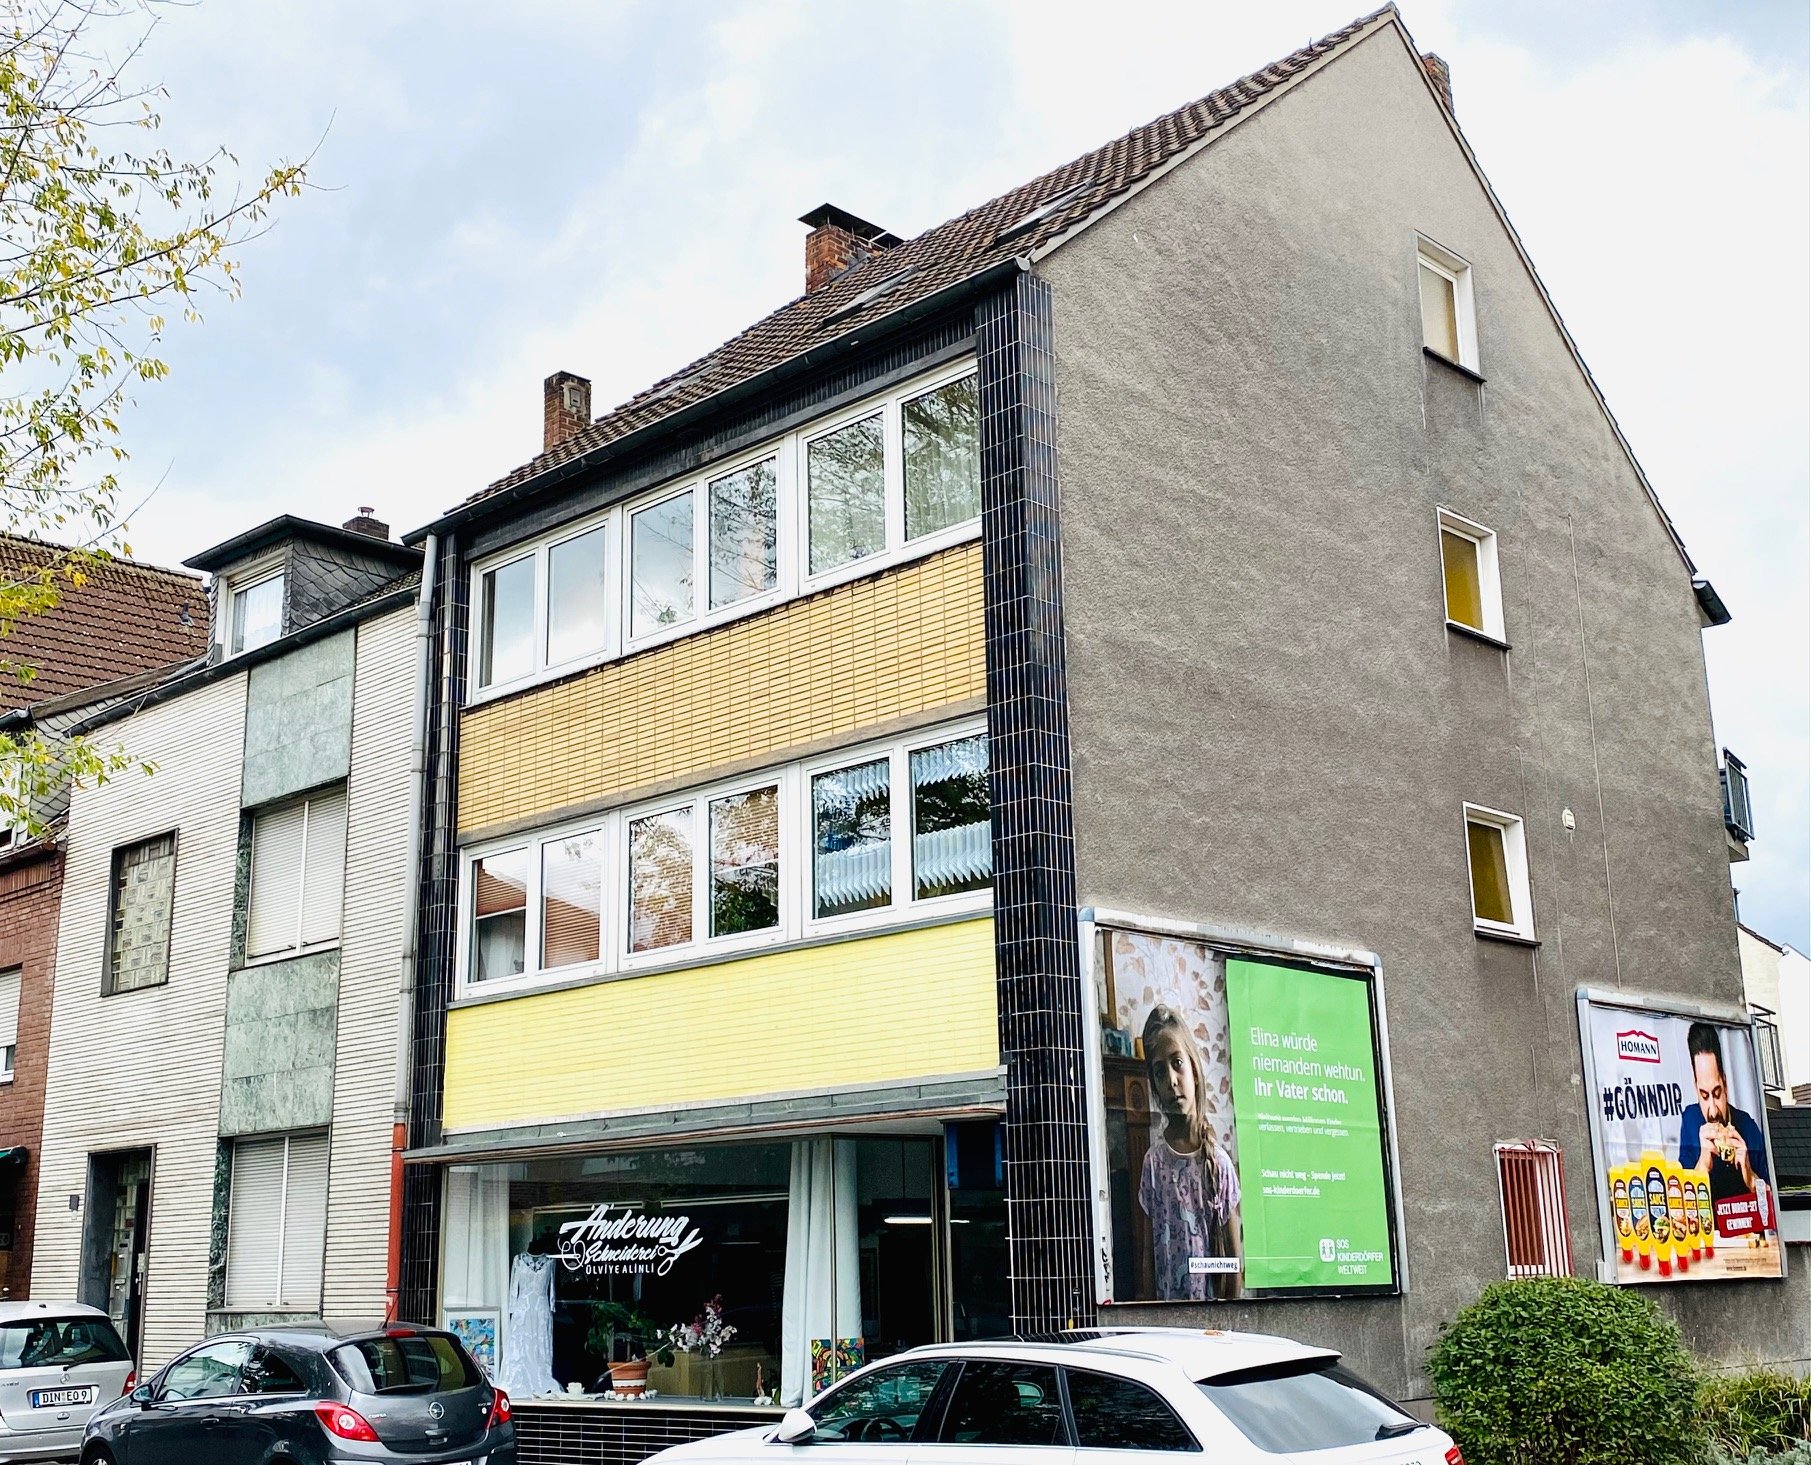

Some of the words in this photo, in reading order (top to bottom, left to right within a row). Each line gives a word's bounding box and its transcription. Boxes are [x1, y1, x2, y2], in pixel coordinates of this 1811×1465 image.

[1250, 1027, 1279, 1048] Elina
[1281, 1033, 1318, 1052] würde
[1620, 1039, 1658, 1056] HOMANN
[1252, 1053, 1322, 1077] niemandem
[1323, 1063, 1366, 1082] wehtun.
[1254, 1077, 1273, 1097] Ihr
[1275, 1080, 1309, 1101] Vater
[1312, 1085, 1349, 1104] schon.
[1603, 1077, 1683, 1122] #GÖNNDIR
[1313, 1127, 1324, 1135] und
[1279, 1169, 1294, 1179] nicht
[559, 1203, 690, 1246] Änderung
[585, 1240, 659, 1264] Schneiderei
[1336, 1238, 1350, 1249] SOS
[1336, 1250, 1384, 1263] KINDERDÖRFER
[1337, 1264, 1368, 1275] WELTWEIT
[42, 1393, 61, 1404] DIN
[81, 1390, 87, 1400] 9
